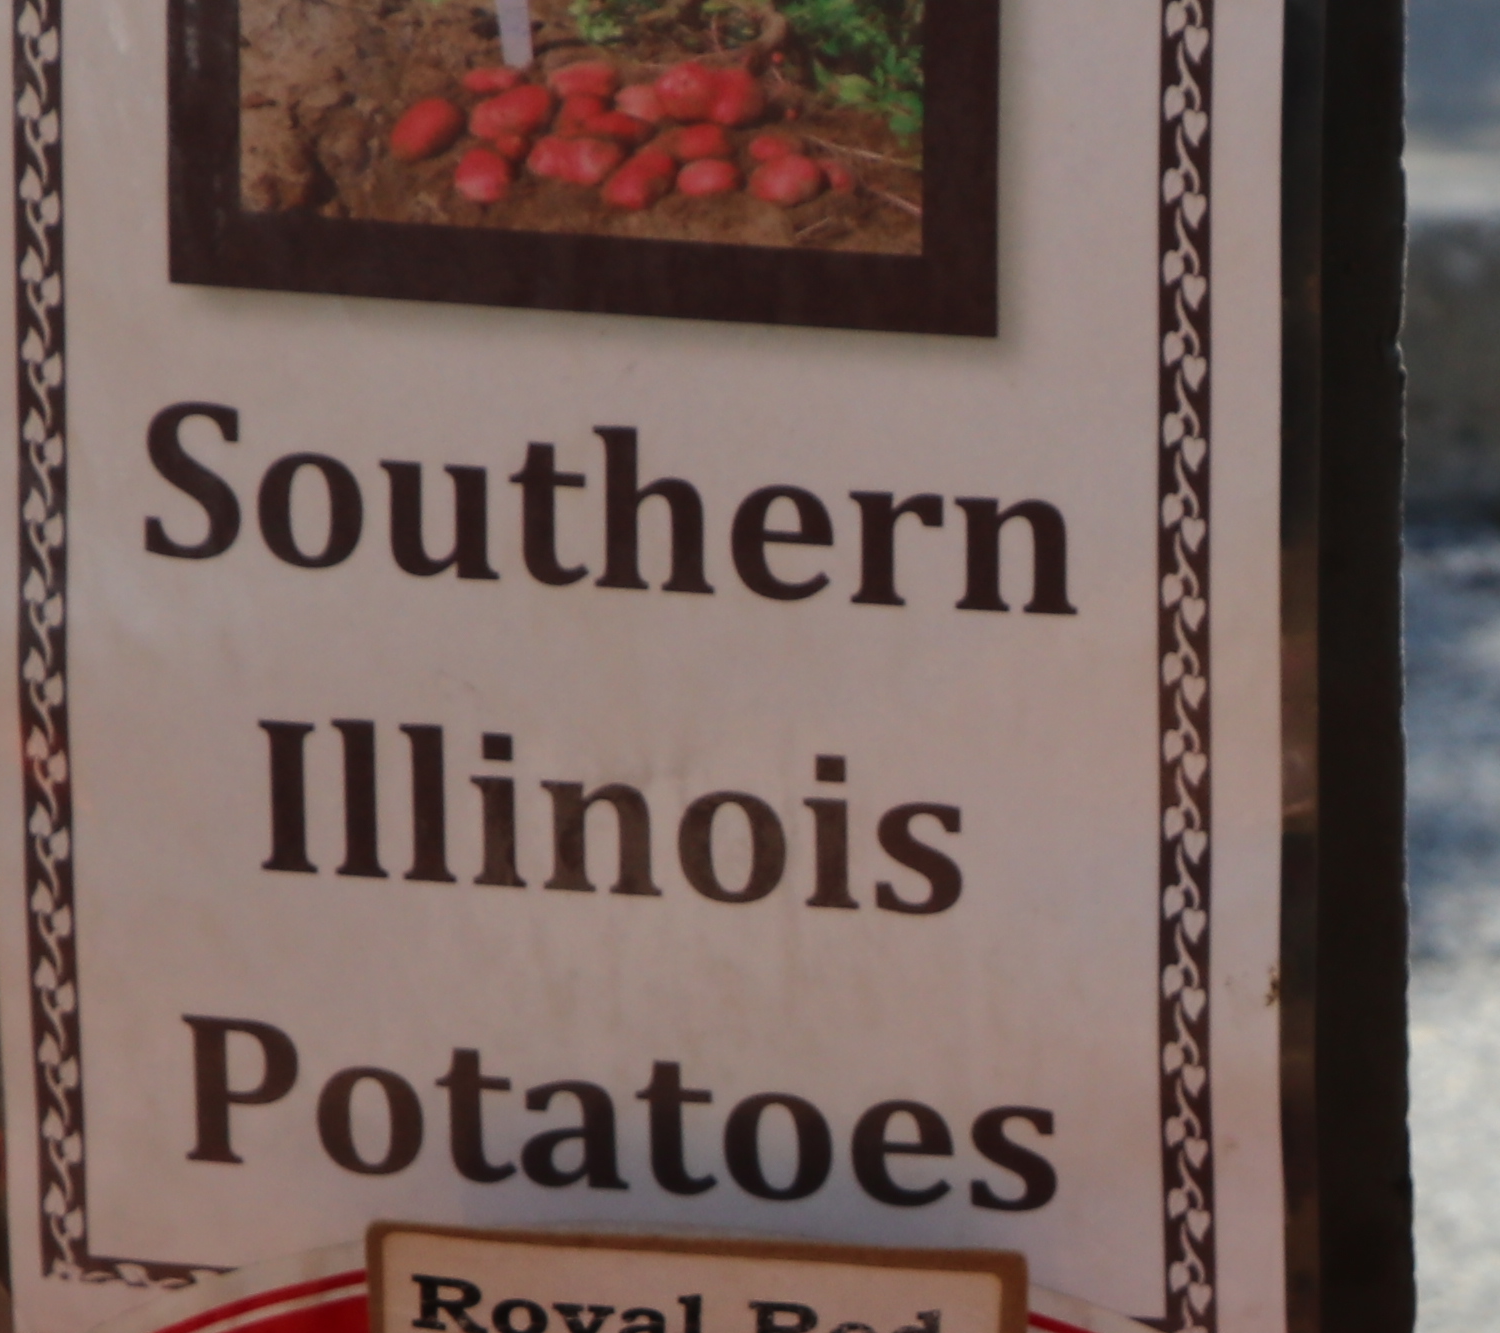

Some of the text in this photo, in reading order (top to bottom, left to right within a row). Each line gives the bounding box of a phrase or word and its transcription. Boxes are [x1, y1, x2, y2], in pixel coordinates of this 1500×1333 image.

[144, 402, 1078, 616] Southern
[258, 718, 963, 916] Illinois
[182, 1015, 1058, 1213] Potatoes
